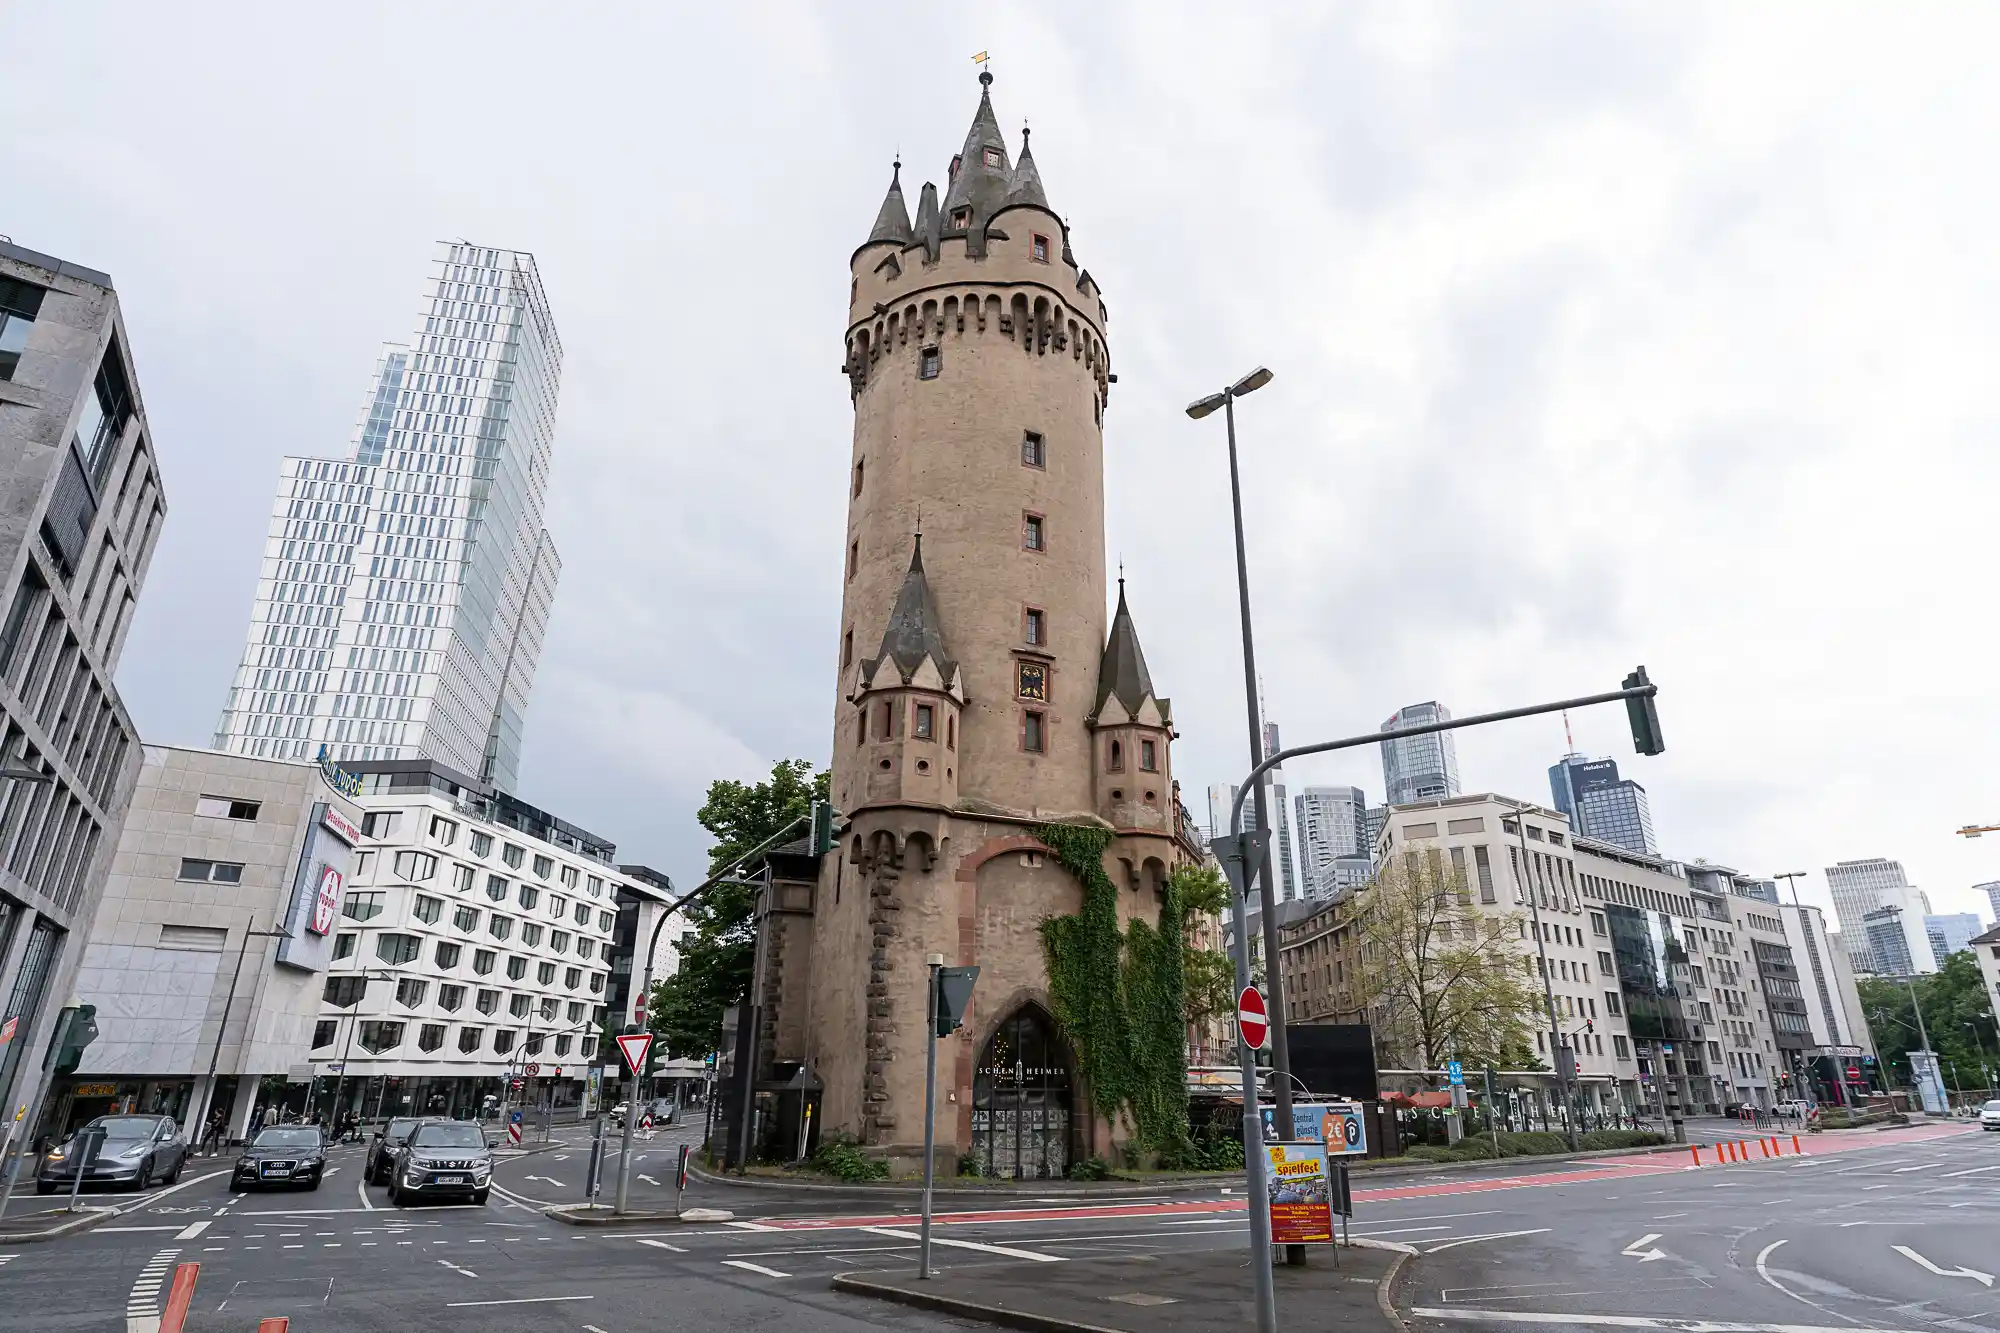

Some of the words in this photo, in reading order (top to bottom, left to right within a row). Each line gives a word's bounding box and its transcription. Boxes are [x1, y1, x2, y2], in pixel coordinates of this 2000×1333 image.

[1583, 763, 1604, 772] Helaba
[337, 768, 364, 796] TUDOR
[1293, 1112, 1314, 1123] Zentral
[1296, 1125, 1319, 1137] günstig
[1327, 1122, 1342, 1138] 2€
[1277, 1160, 1319, 1176] spielfest
